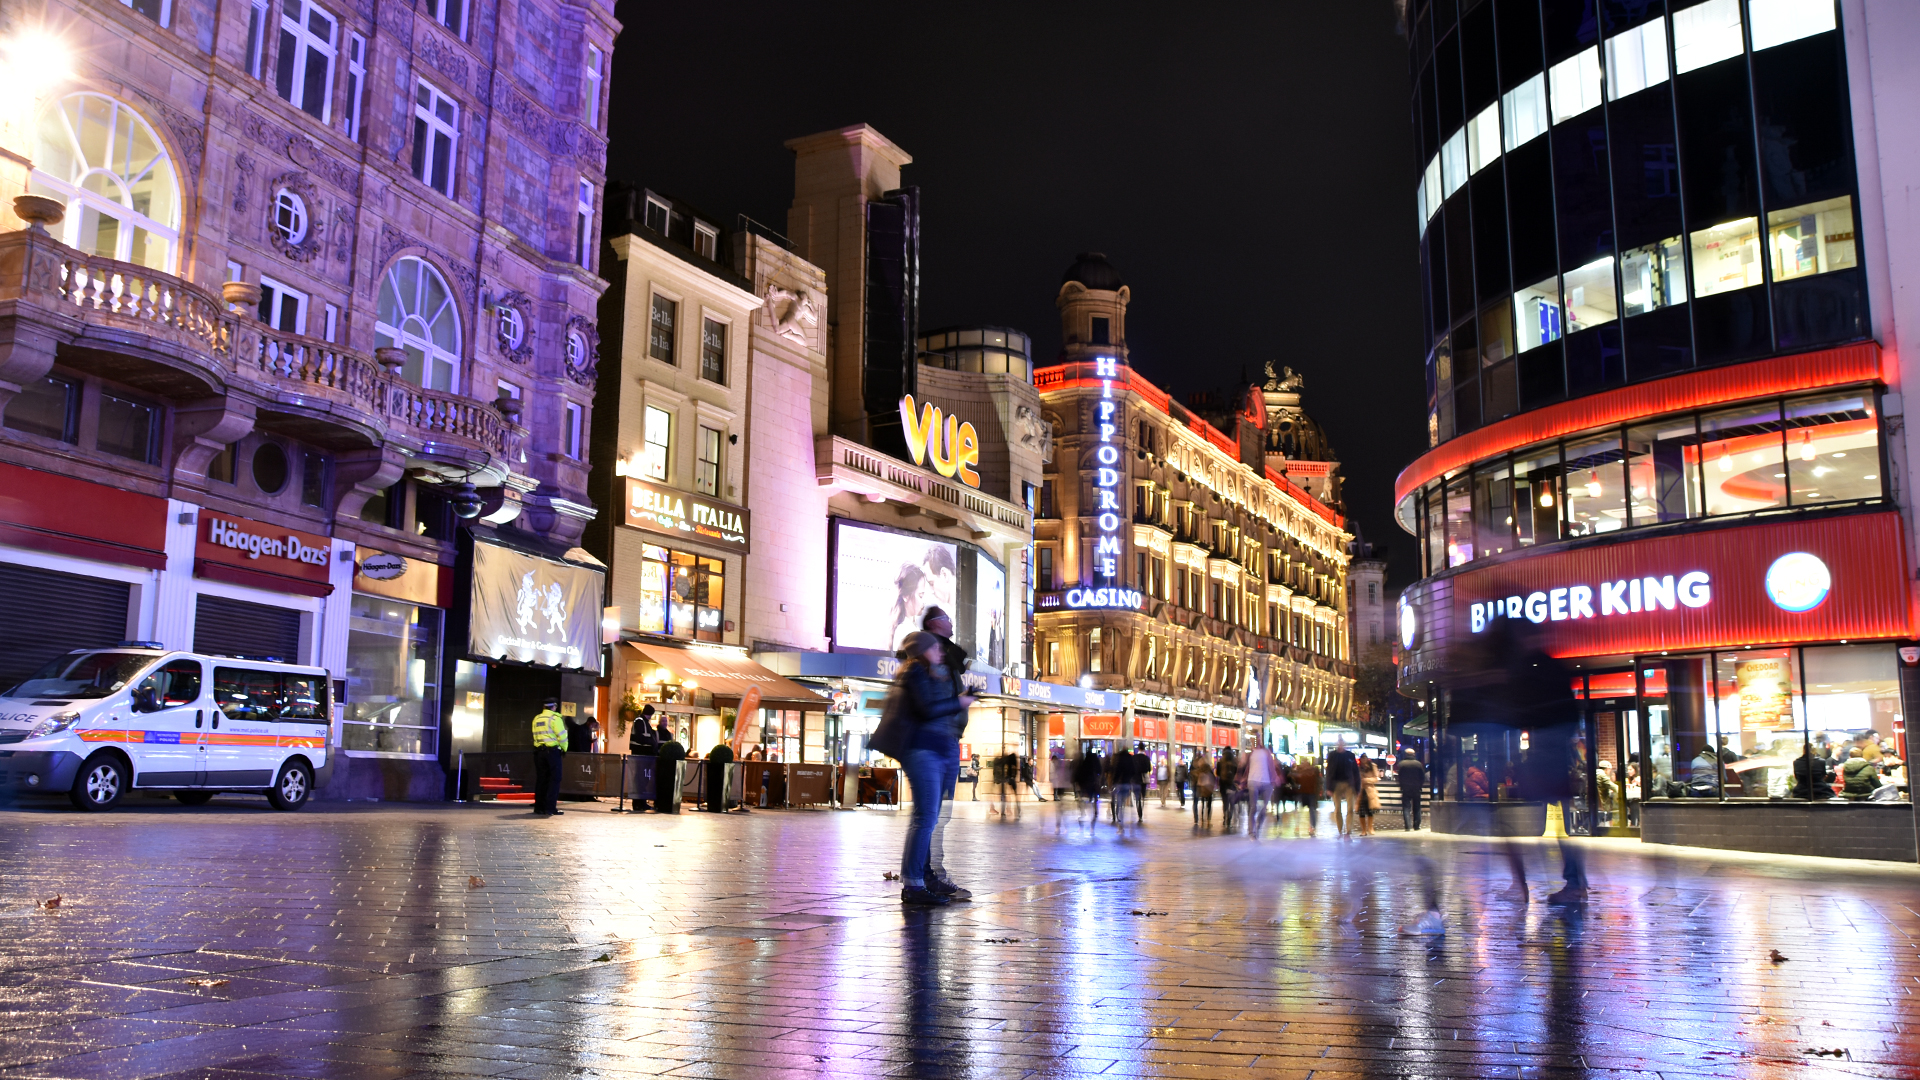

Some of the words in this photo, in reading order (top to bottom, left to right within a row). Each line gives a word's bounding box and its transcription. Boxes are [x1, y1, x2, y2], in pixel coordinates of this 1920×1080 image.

[1096, 358, 1121, 577] HIPPODROME
[632, 486, 685, 519] BELLA
[692, 503, 744, 534] ITALIA
[210, 518, 327, 566] Häagen-Dazs
[1067, 588, 1142, 609] CASINO
[1470, 585, 1594, 634] BURGER
[1600, 571, 1711, 616] KING
[1746, 662, 1779, 672] CHEDDAR
[1089, 721, 1114, 732] SLOTS
[497, 763, 510, 774] 14
[581, 764, 592, 775] 14
[643, 768, 652, 780] 14
